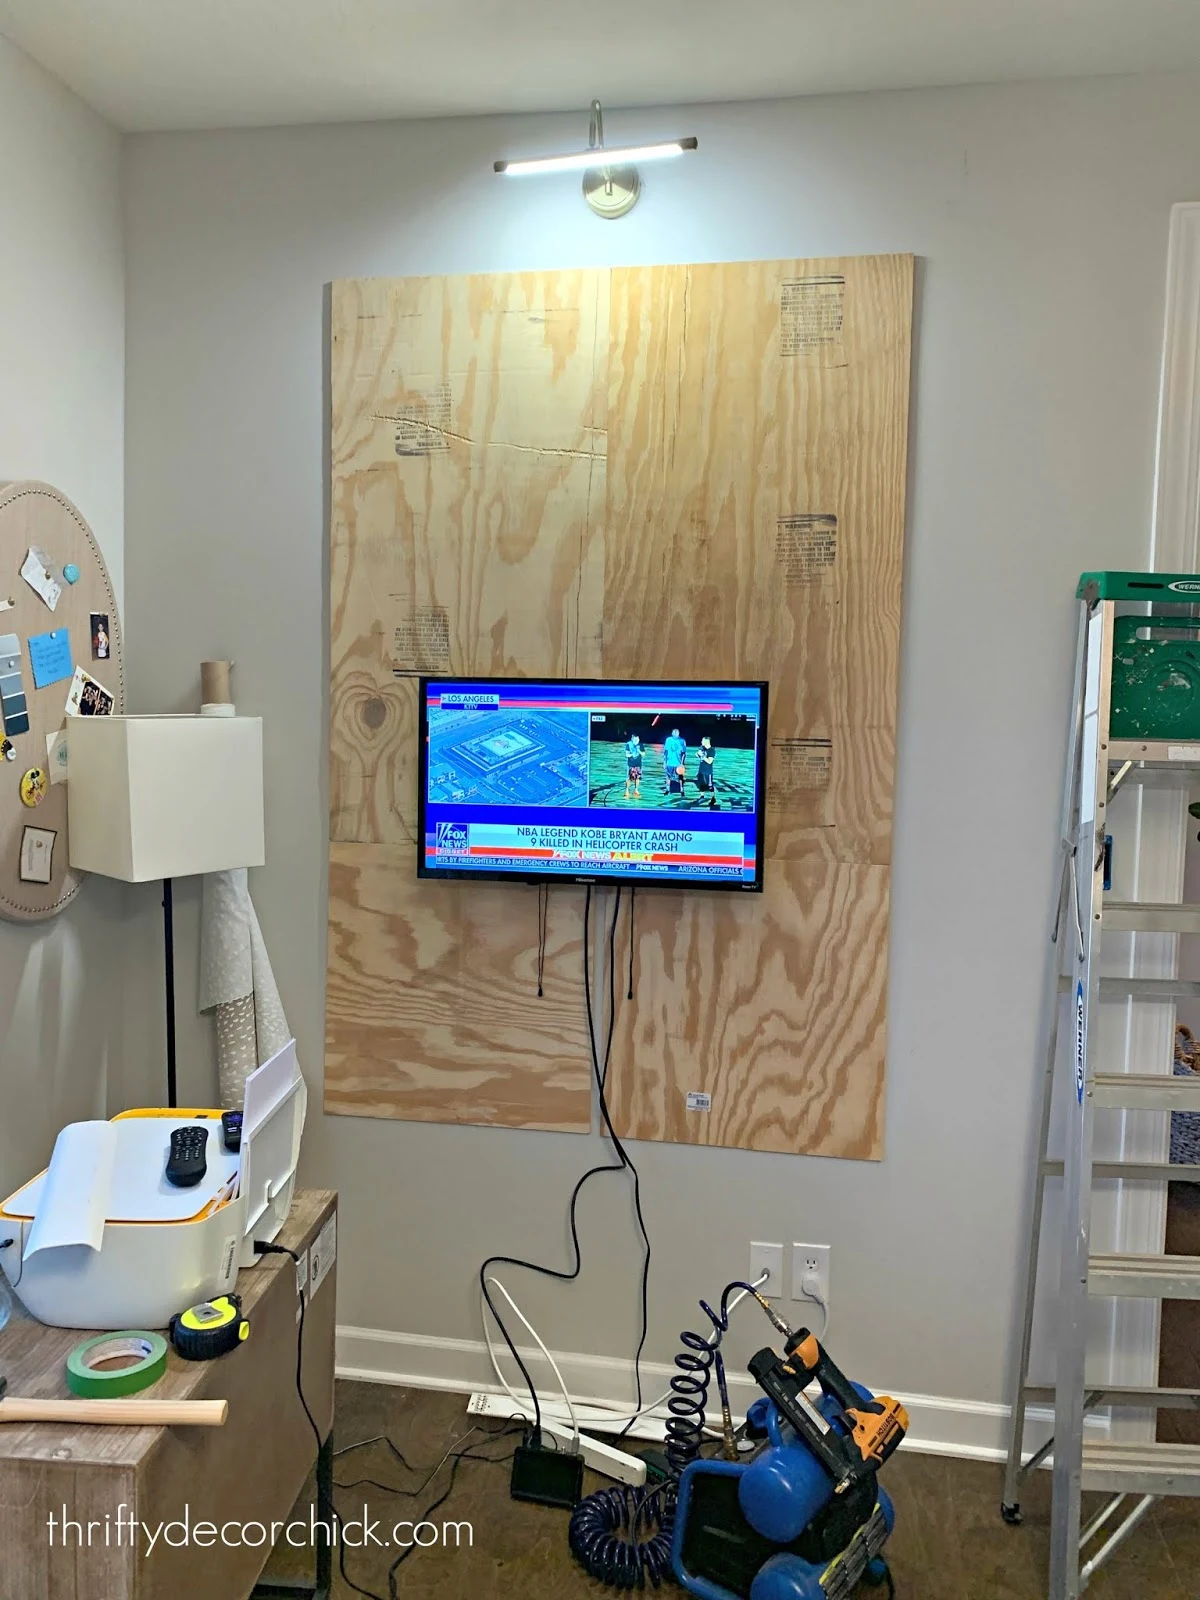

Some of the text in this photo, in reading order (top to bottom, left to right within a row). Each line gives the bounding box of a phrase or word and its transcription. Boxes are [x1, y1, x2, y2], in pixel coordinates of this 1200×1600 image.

[463, 695, 494, 703] ANGELES
[447, 830, 466, 840] FOX
[517, 827, 693, 842] NBA LEGEND KOBE BRYANT AMONG
[441, 839, 467, 848] NEWS
[531, 838, 678, 852] 9 KILLED IN HELICOPTER CRASH
[560, 850, 580, 859] FOX
[582, 851, 611, 860] NEWS
[498, 858, 511, 866] AND
[512, 859, 547, 867] EMERGENCY
[549, 860, 570, 868] CREWS
[580, 861, 600, 869] REACH
[602, 862, 630, 870] AIRCRAFT
[678, 865, 707, 873] ARIZONA
[708, 866, 740, 875] OFFICIALS
